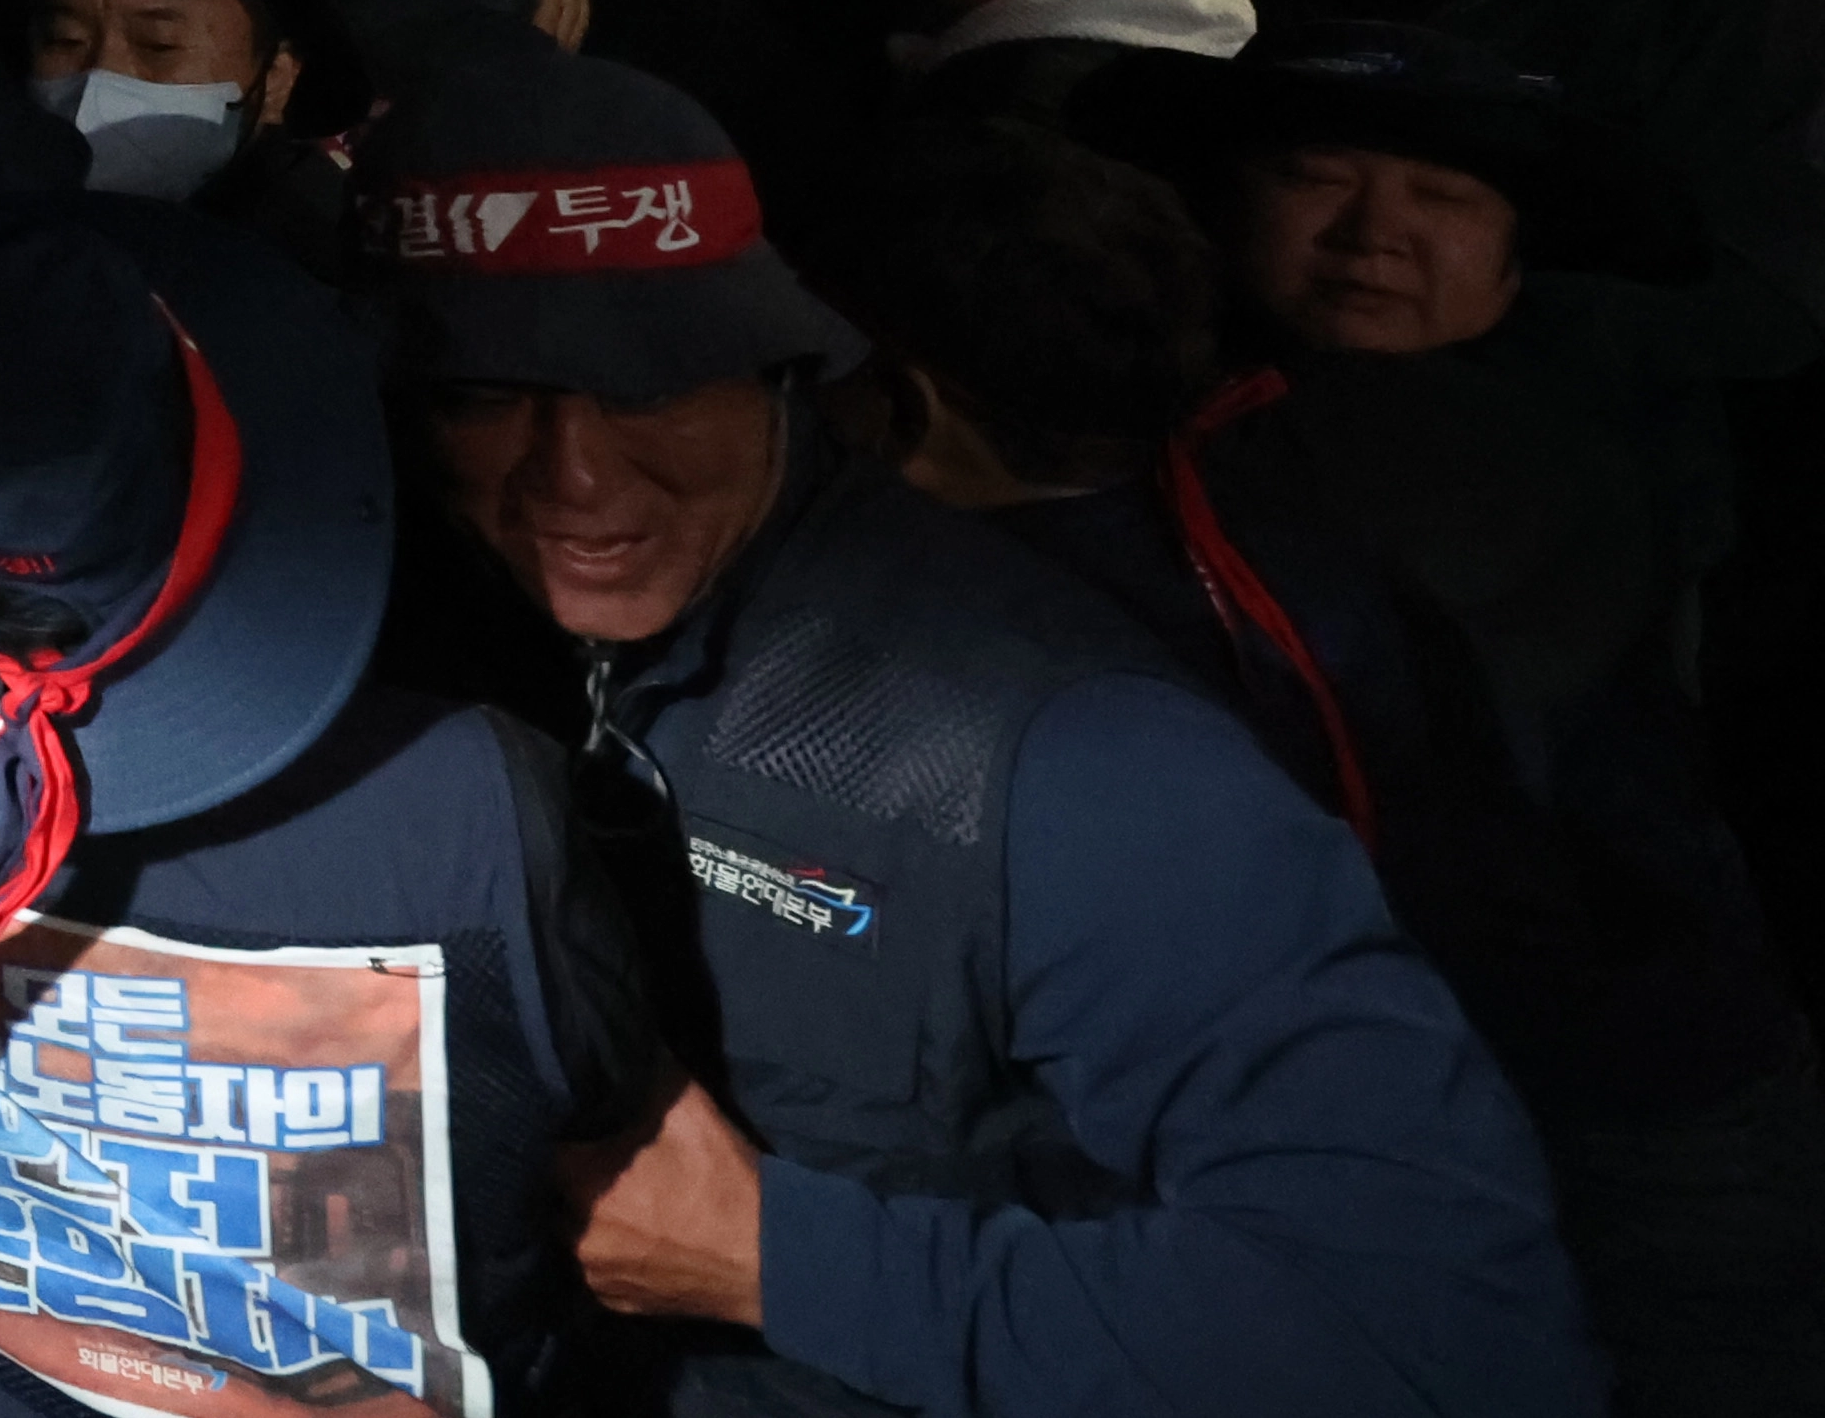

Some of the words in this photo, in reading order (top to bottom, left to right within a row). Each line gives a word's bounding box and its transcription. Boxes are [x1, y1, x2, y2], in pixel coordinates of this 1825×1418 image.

[549, 180, 701, 255] 투쟁
[688, 852, 834, 934] 화물연대본부
[1, 964, 189, 1059] 모든
[4, 1036, 386, 1149] 노동자의
